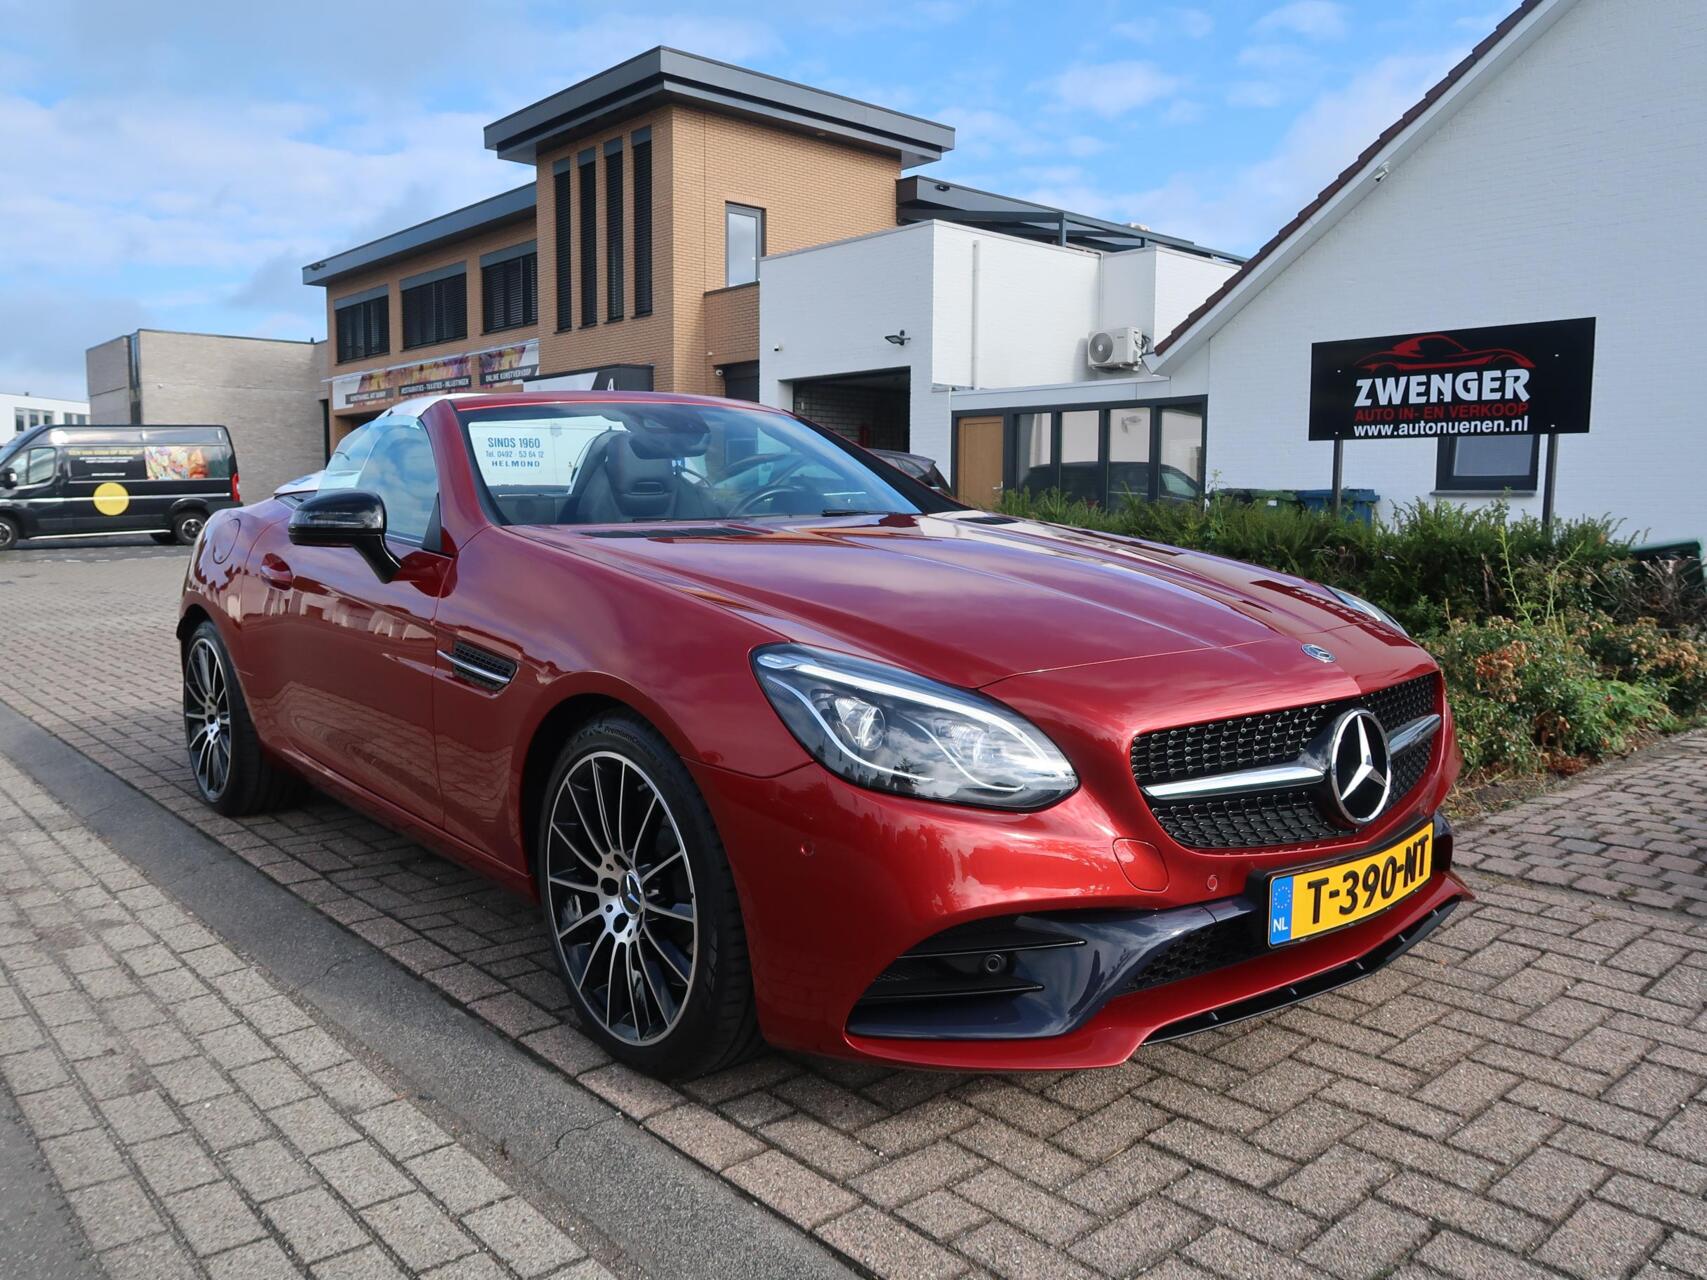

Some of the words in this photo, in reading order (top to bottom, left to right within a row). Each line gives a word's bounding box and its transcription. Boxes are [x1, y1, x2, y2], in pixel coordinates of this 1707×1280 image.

[1354, 368, 1530, 407] ZWENGER
[1355, 408, 1395, 421] AUTO
[1400, 407, 1419, 420] IN-
[1423, 406, 1445, 419] EN
[1448, 402, 1529, 418] VERKOOP
[1354, 415, 1529, 437] www.autonuenen.nl
[487, 437, 516, 448] SINDS
[519, 437, 541, 448] 1960
[491, 460, 540, 468] HELMOND
[1307, 834, 1429, 924] T-390-NT
[1272, 917, 1289, 932] NL
